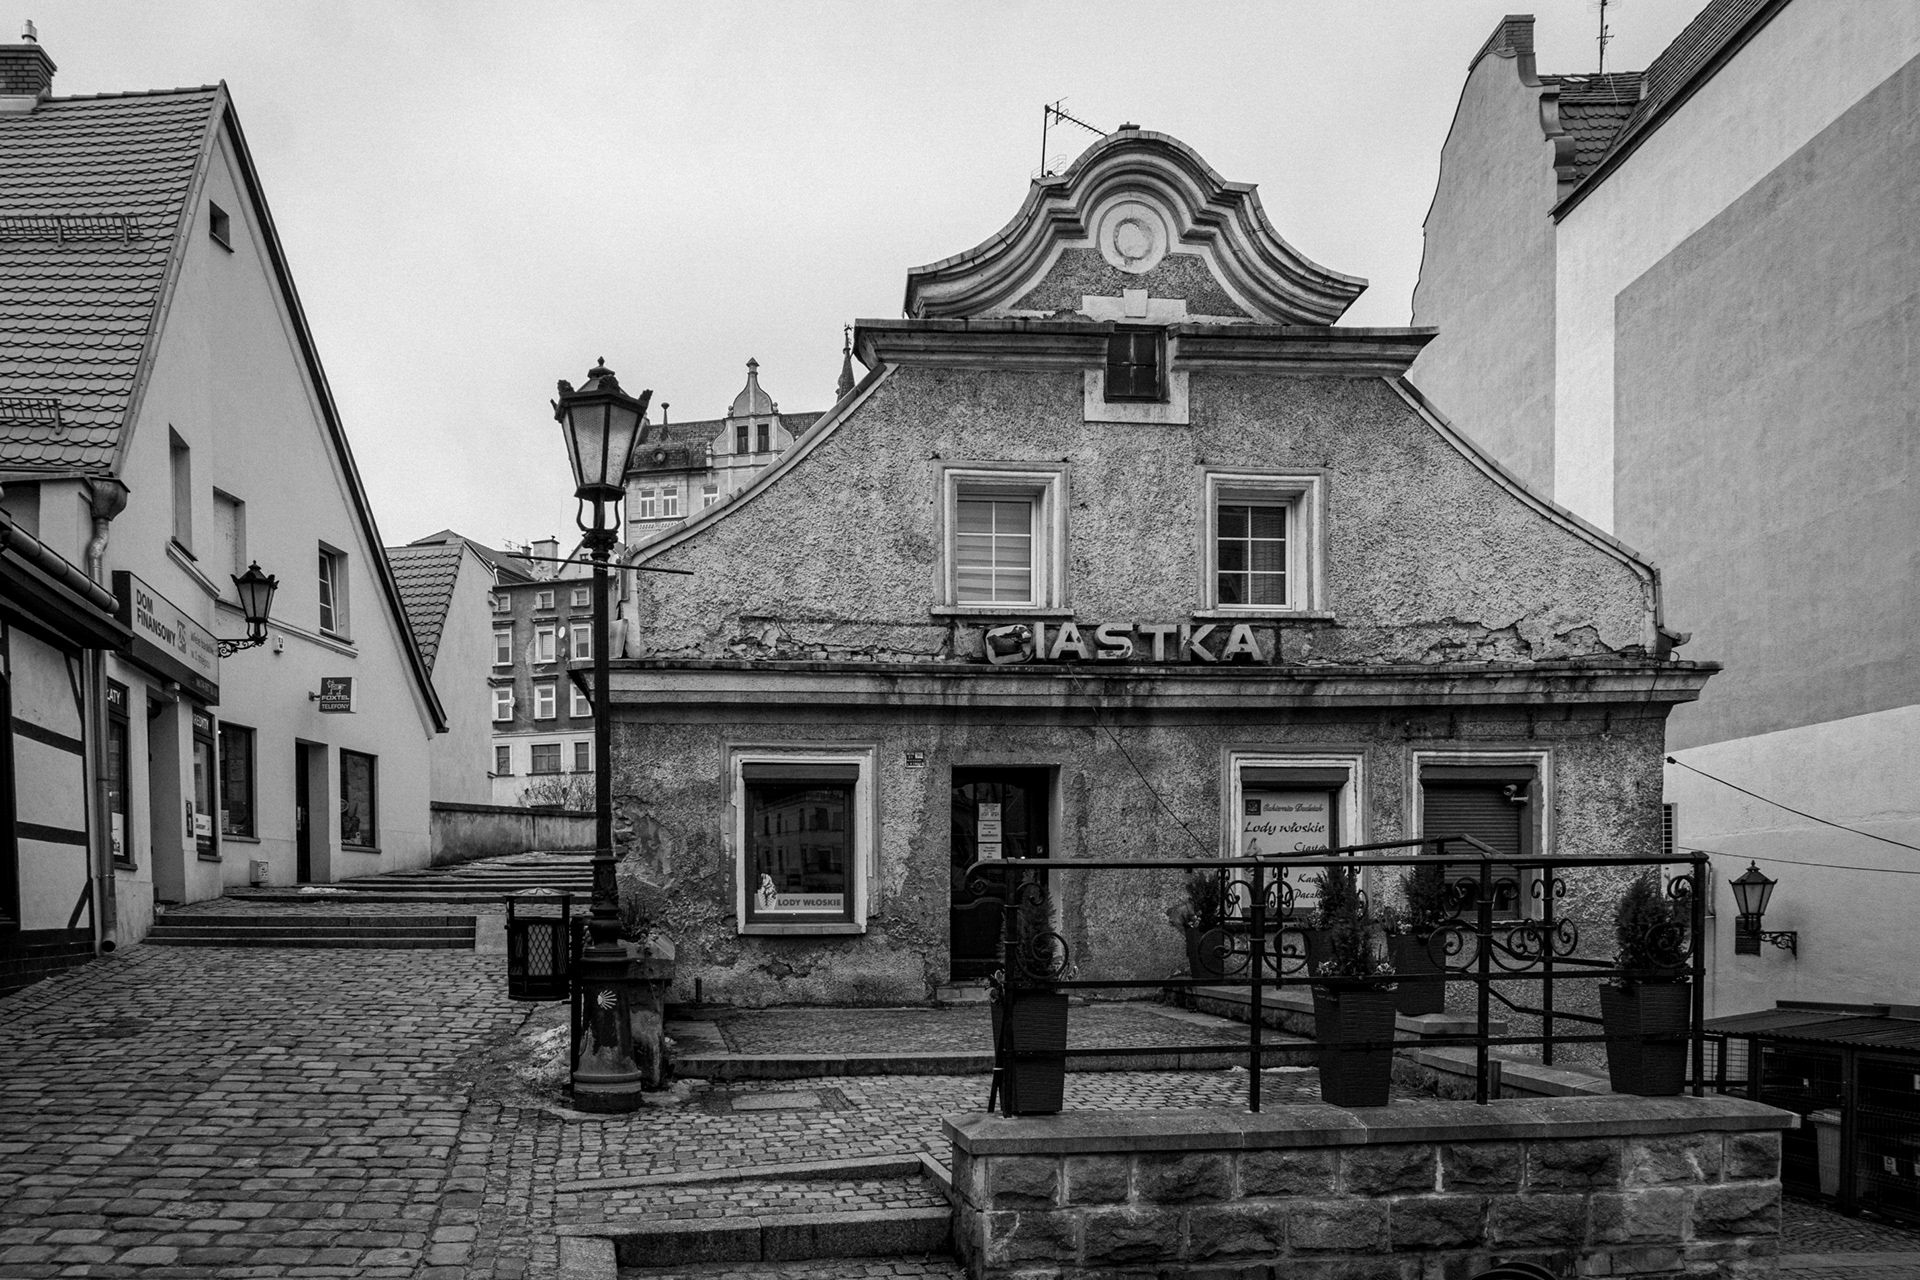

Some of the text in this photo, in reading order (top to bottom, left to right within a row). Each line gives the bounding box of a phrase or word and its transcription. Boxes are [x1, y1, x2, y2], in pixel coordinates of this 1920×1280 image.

[136, 588, 153, 614] DOM
[137, 607, 176, 647] FINANSOWY
[985, 621, 1264, 664] CIASTKA
[192, 713, 209, 731] REDYTY
[1244, 822, 1325, 835] Lody włoskie
[1293, 889, 1322, 900] Pączk
